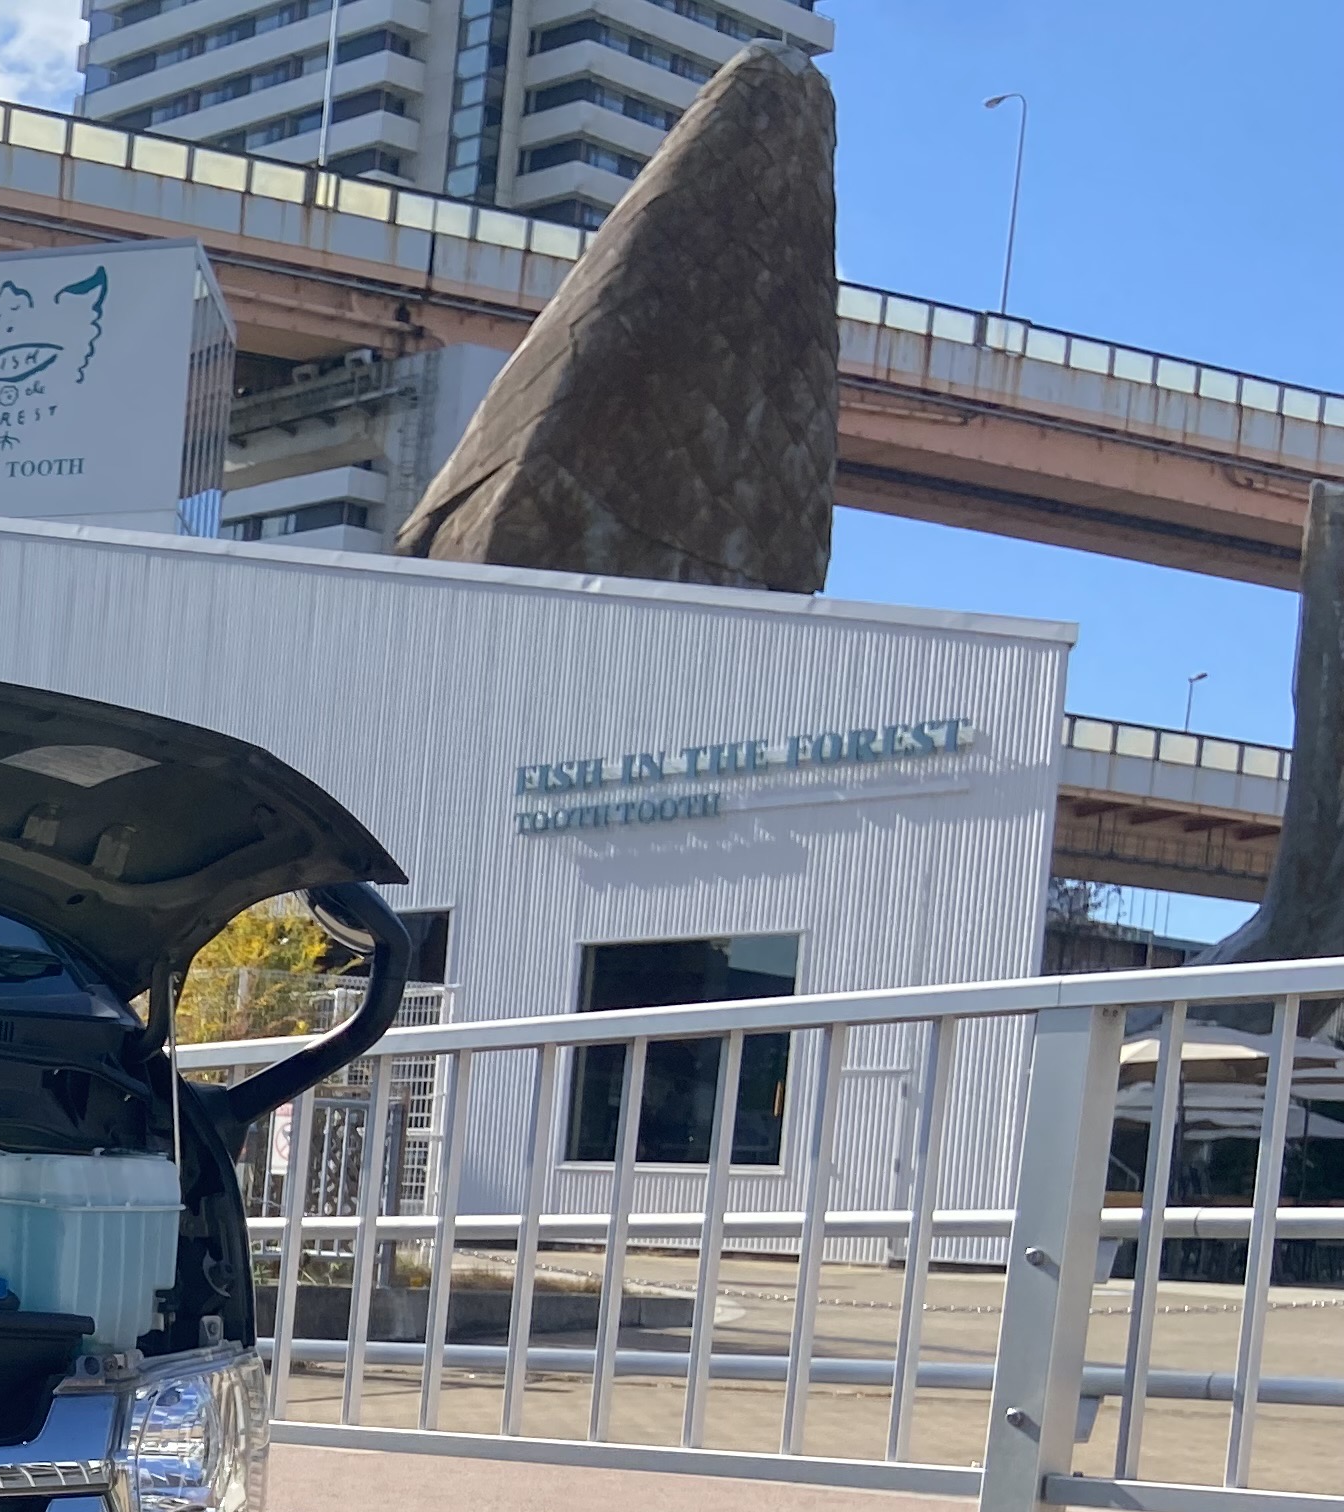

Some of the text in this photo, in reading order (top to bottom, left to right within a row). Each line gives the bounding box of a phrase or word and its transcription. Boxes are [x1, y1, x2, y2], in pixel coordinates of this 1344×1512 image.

[6, 458, 85, 478] TOOTH
[515, 718, 971, 796] FISH IN THE FOREST
[514, 792, 721, 835] TOOTH TOOTH
